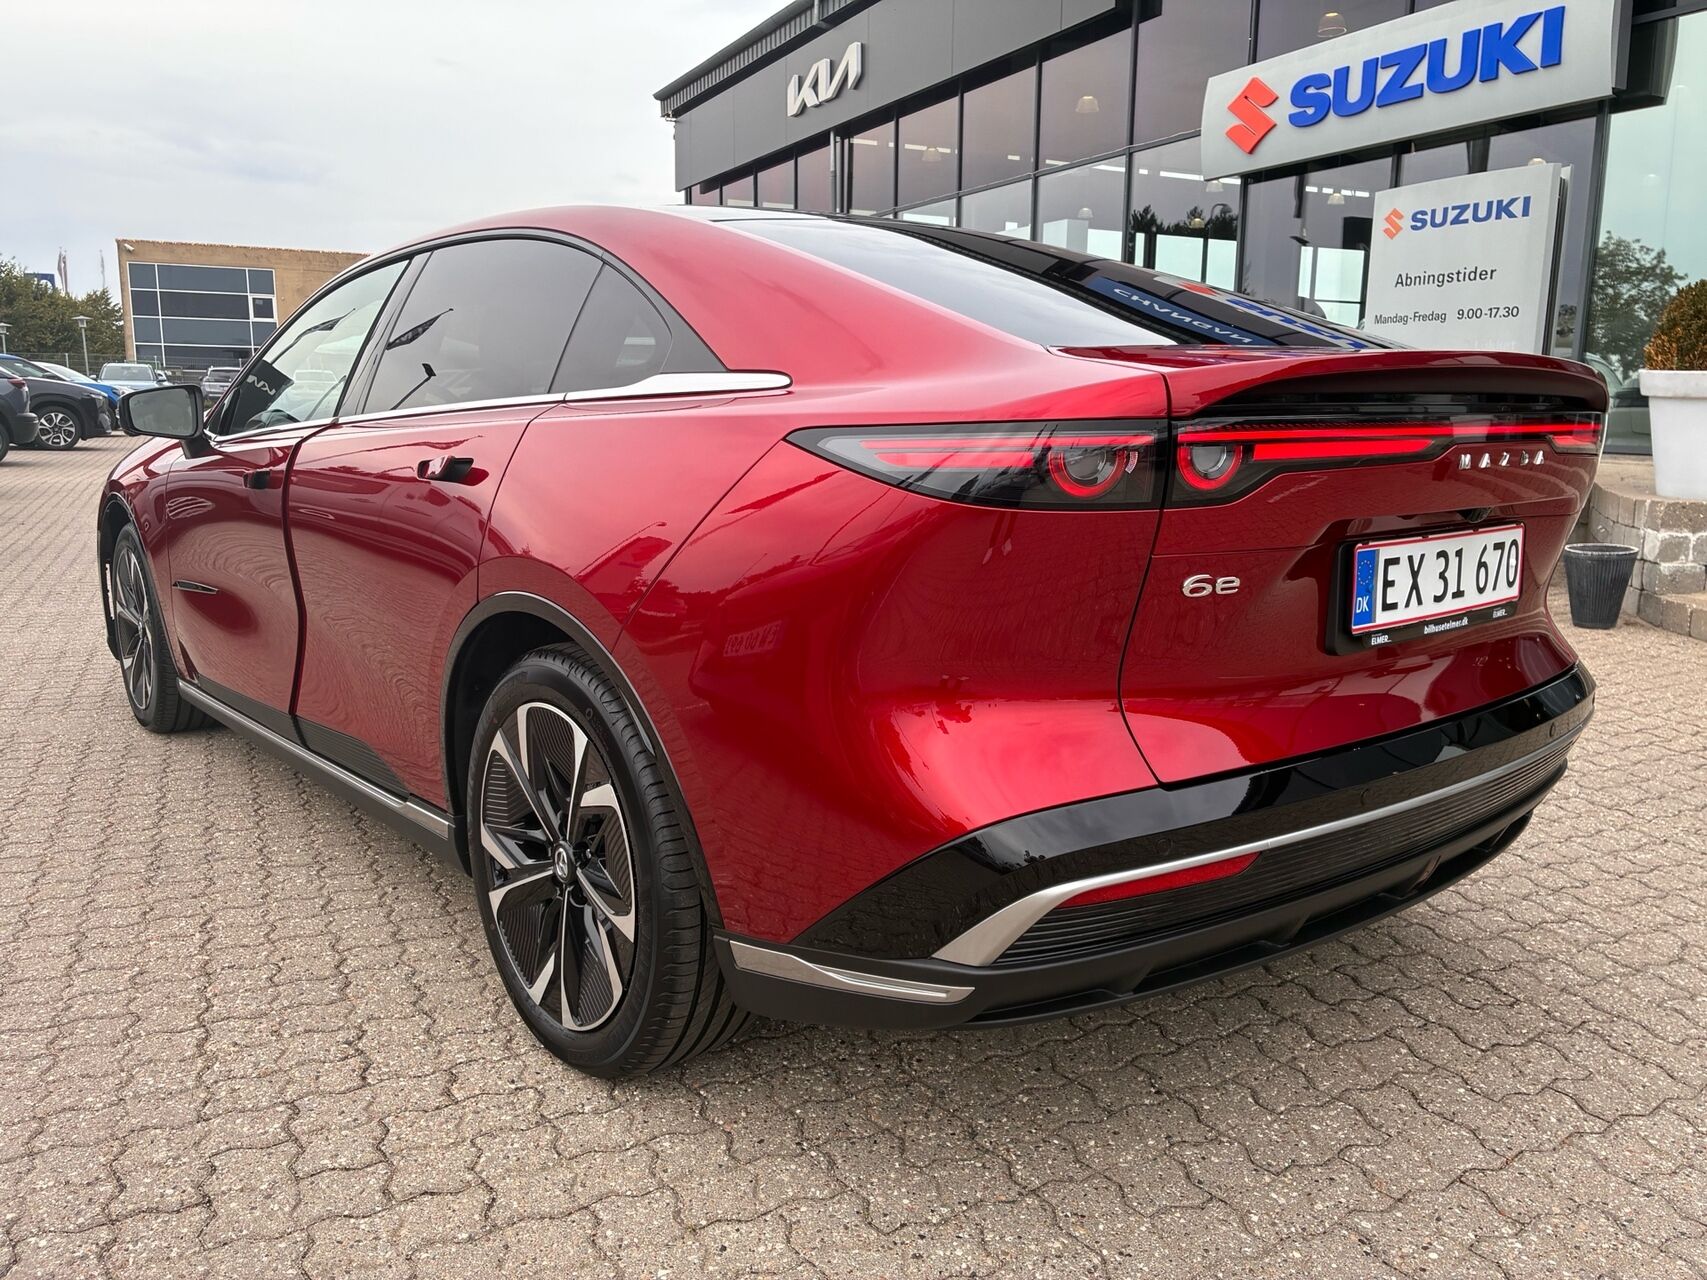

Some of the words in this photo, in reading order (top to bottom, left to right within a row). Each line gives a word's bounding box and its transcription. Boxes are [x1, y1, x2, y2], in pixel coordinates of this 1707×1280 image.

[1288, 6, 1565, 127] SUZUKI
[1410, 195, 1531, 231] SUZUKI
[1395, 266, 1497, 288] Abningstider
[1374, 311, 1447, 325] Mandag-Fredag
[1459, 450, 1545, 469] MAZDA
[1182, 574, 1241, 598] 6e
[1355, 595, 1369, 613] DK
[1381, 553, 1425, 612] EX
[1433, 547, 1465, 602] 31
[1475, 538, 1519, 594] 670
